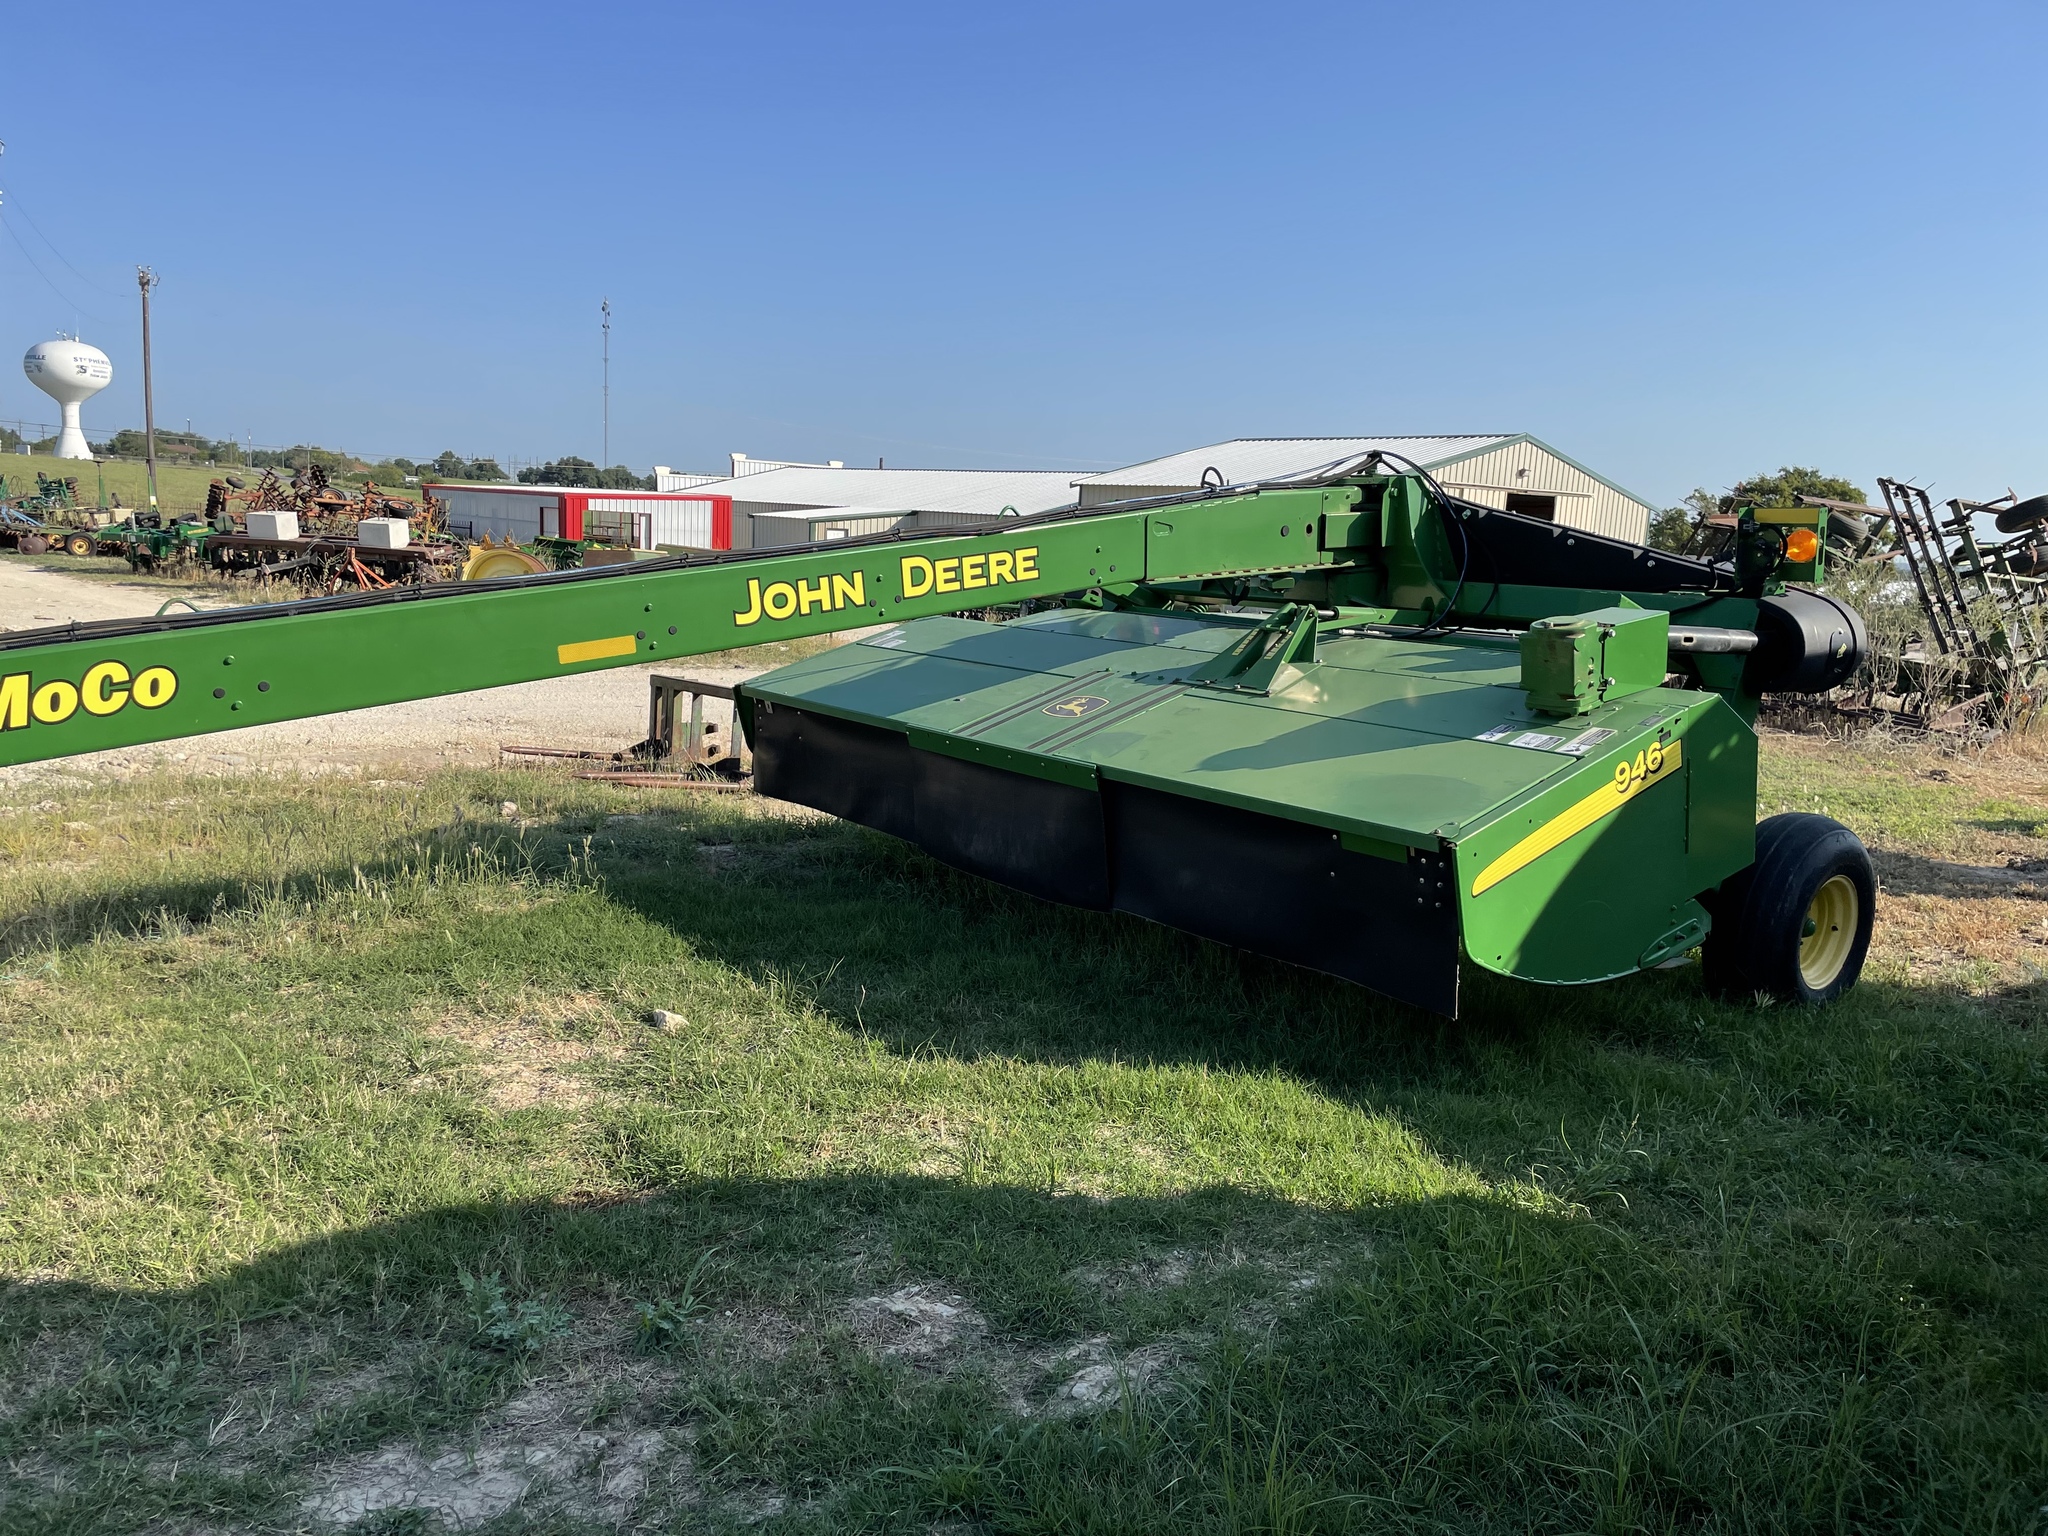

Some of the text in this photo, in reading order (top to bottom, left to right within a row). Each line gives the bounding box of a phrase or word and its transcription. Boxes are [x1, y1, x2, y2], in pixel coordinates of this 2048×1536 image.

[733, 546, 1040, 627] JOHN DEERE
[1614, 741, 1664, 793] 946
